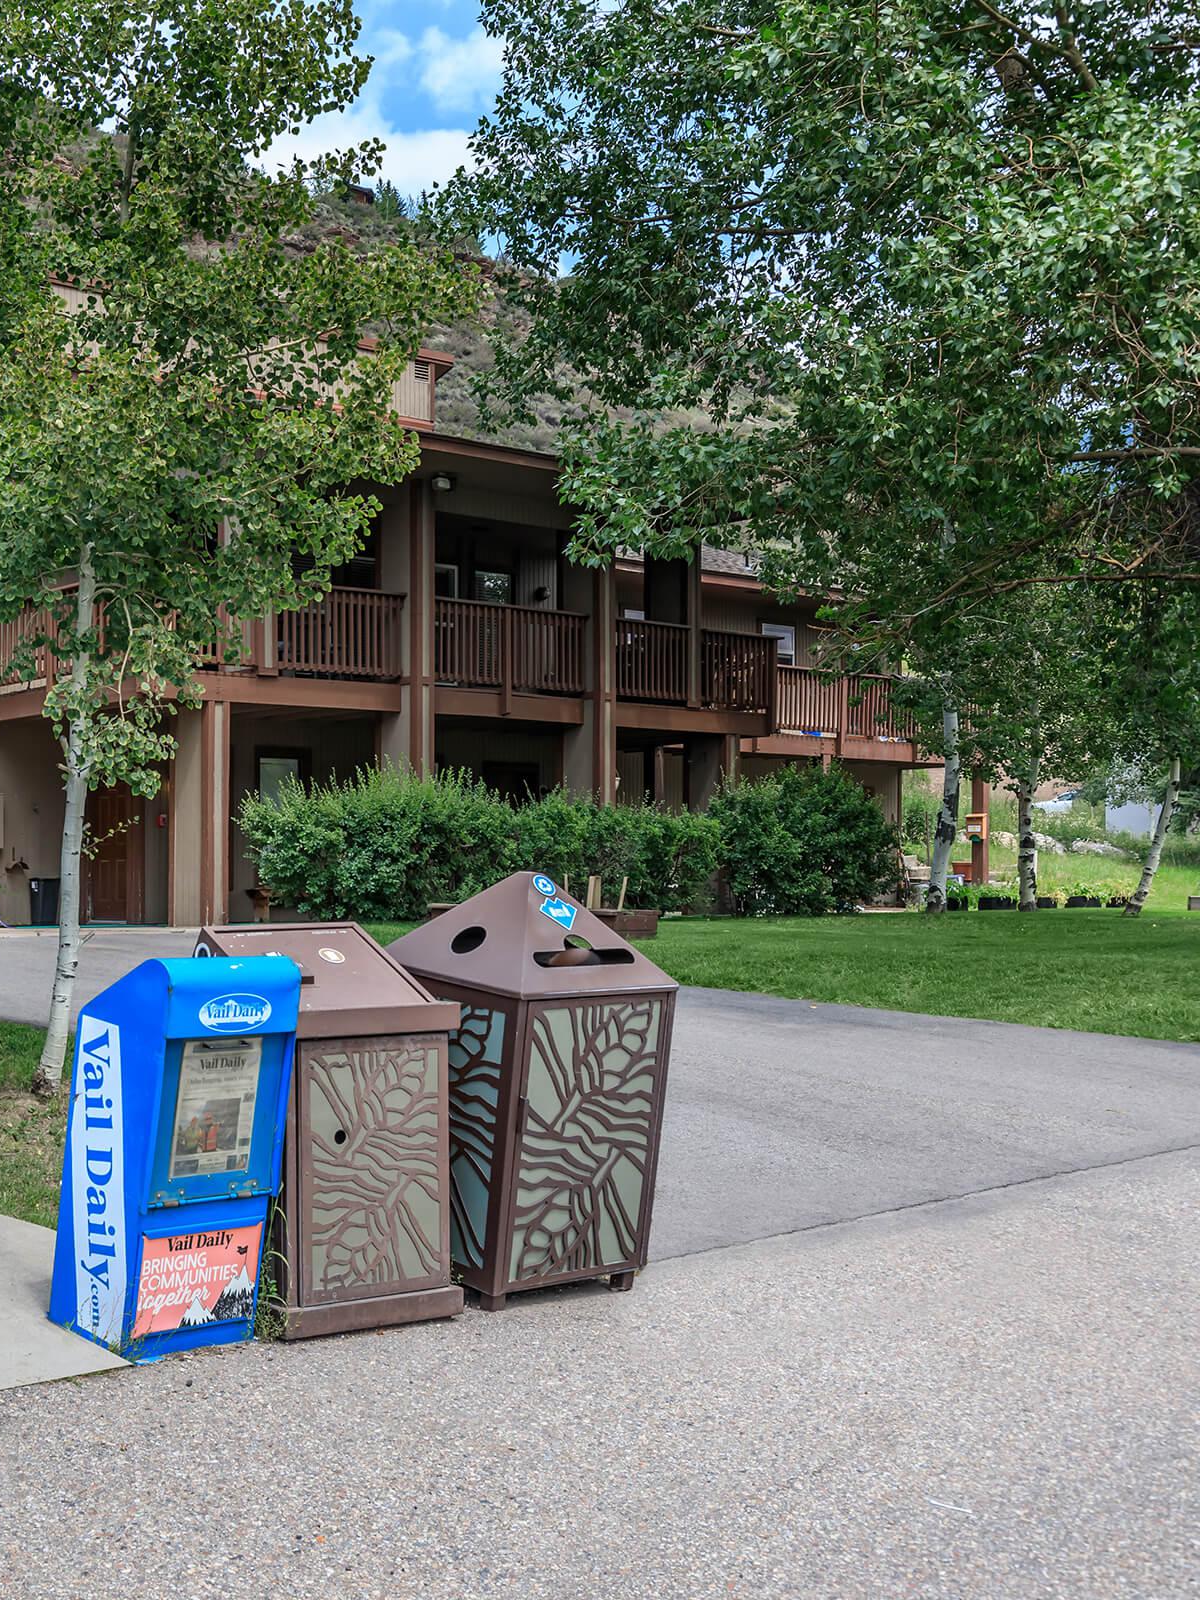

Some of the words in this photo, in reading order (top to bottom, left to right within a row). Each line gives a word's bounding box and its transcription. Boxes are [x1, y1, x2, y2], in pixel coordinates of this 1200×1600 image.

[207, 1003, 229, 1019] Vail
[200, 1058, 218, 1070] Vail
[220, 1056, 246, 1071] Daily
[83, 1028, 113, 1131] Vail
[81, 1145, 116, 1327] Daily.com
[167, 1235, 193, 1252] Vail
[196, 1231, 233, 1249] Daily
[142, 1252, 207, 1276] BRINGING
[140, 1264, 238, 1292] COMMUNITIES
